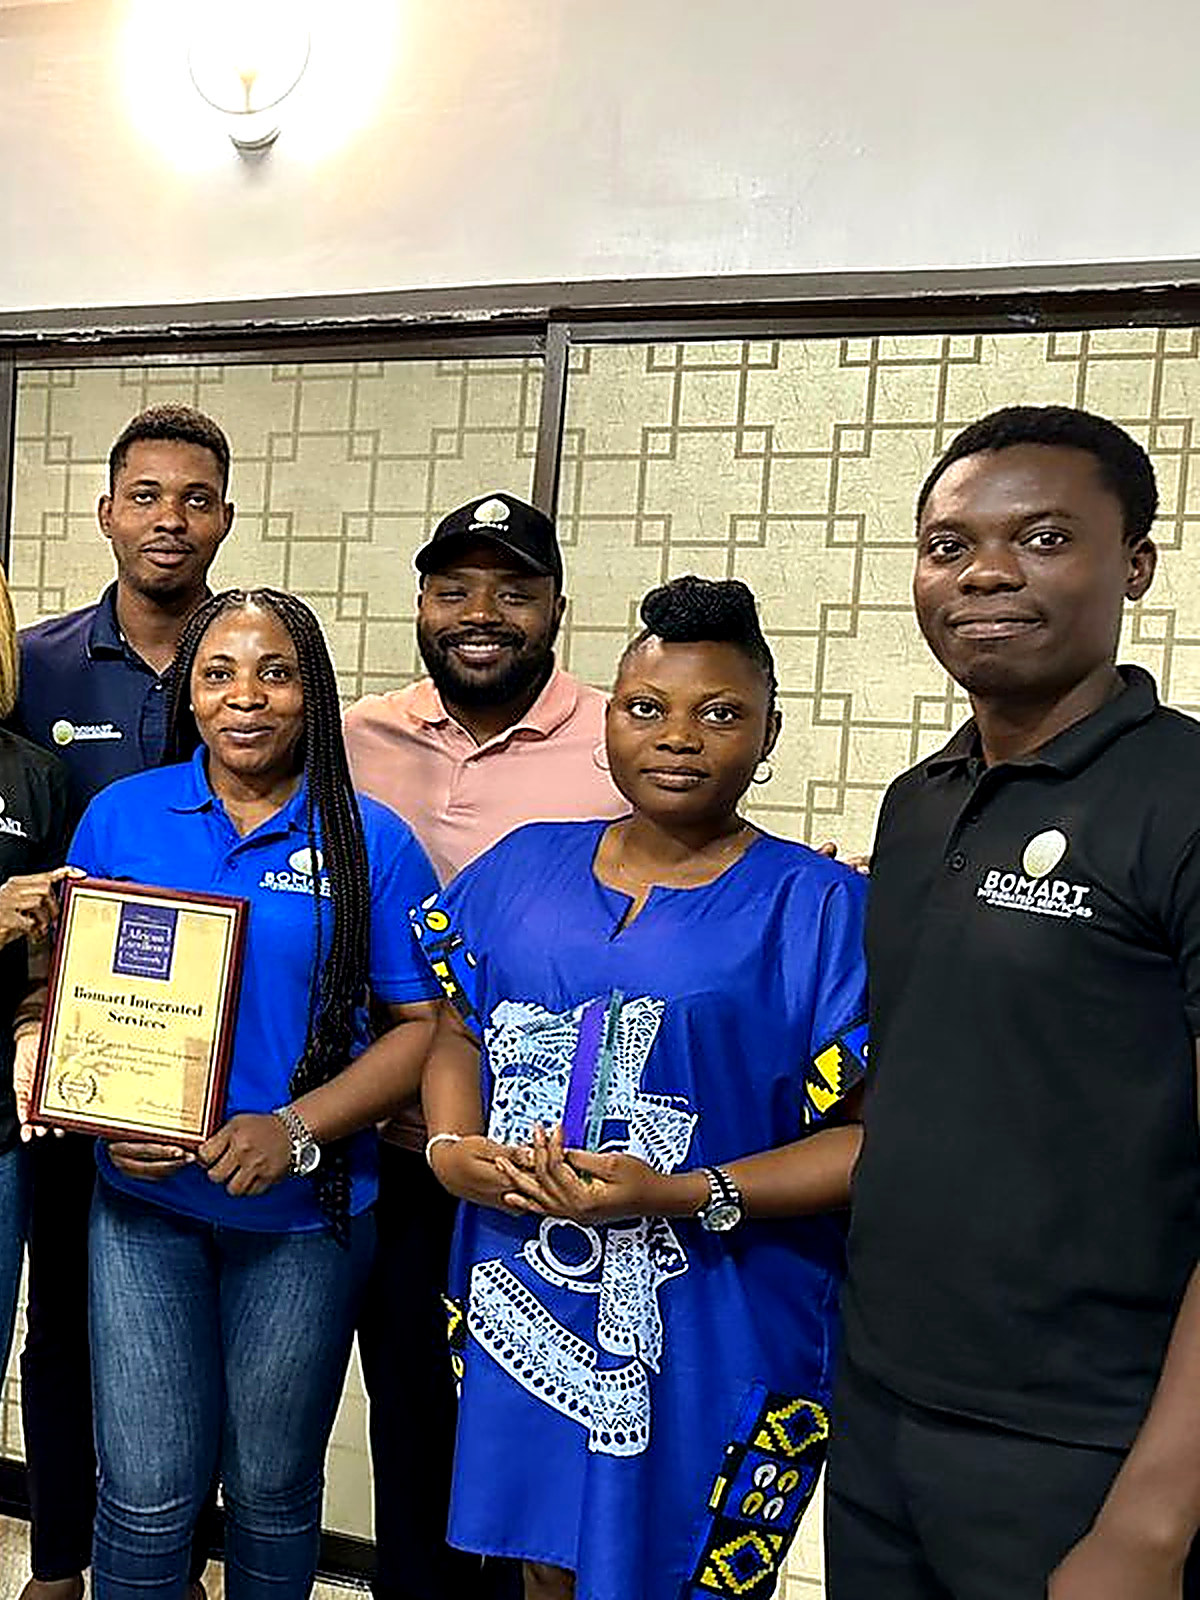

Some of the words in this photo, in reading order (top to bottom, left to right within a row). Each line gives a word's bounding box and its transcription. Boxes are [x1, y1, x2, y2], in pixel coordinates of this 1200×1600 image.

[984, 869, 1091, 907] BOMART
[74, 986, 126, 1005] Bomart
[130, 994, 203, 1017] Integrated
[107, 1011, 167, 1029] Services
